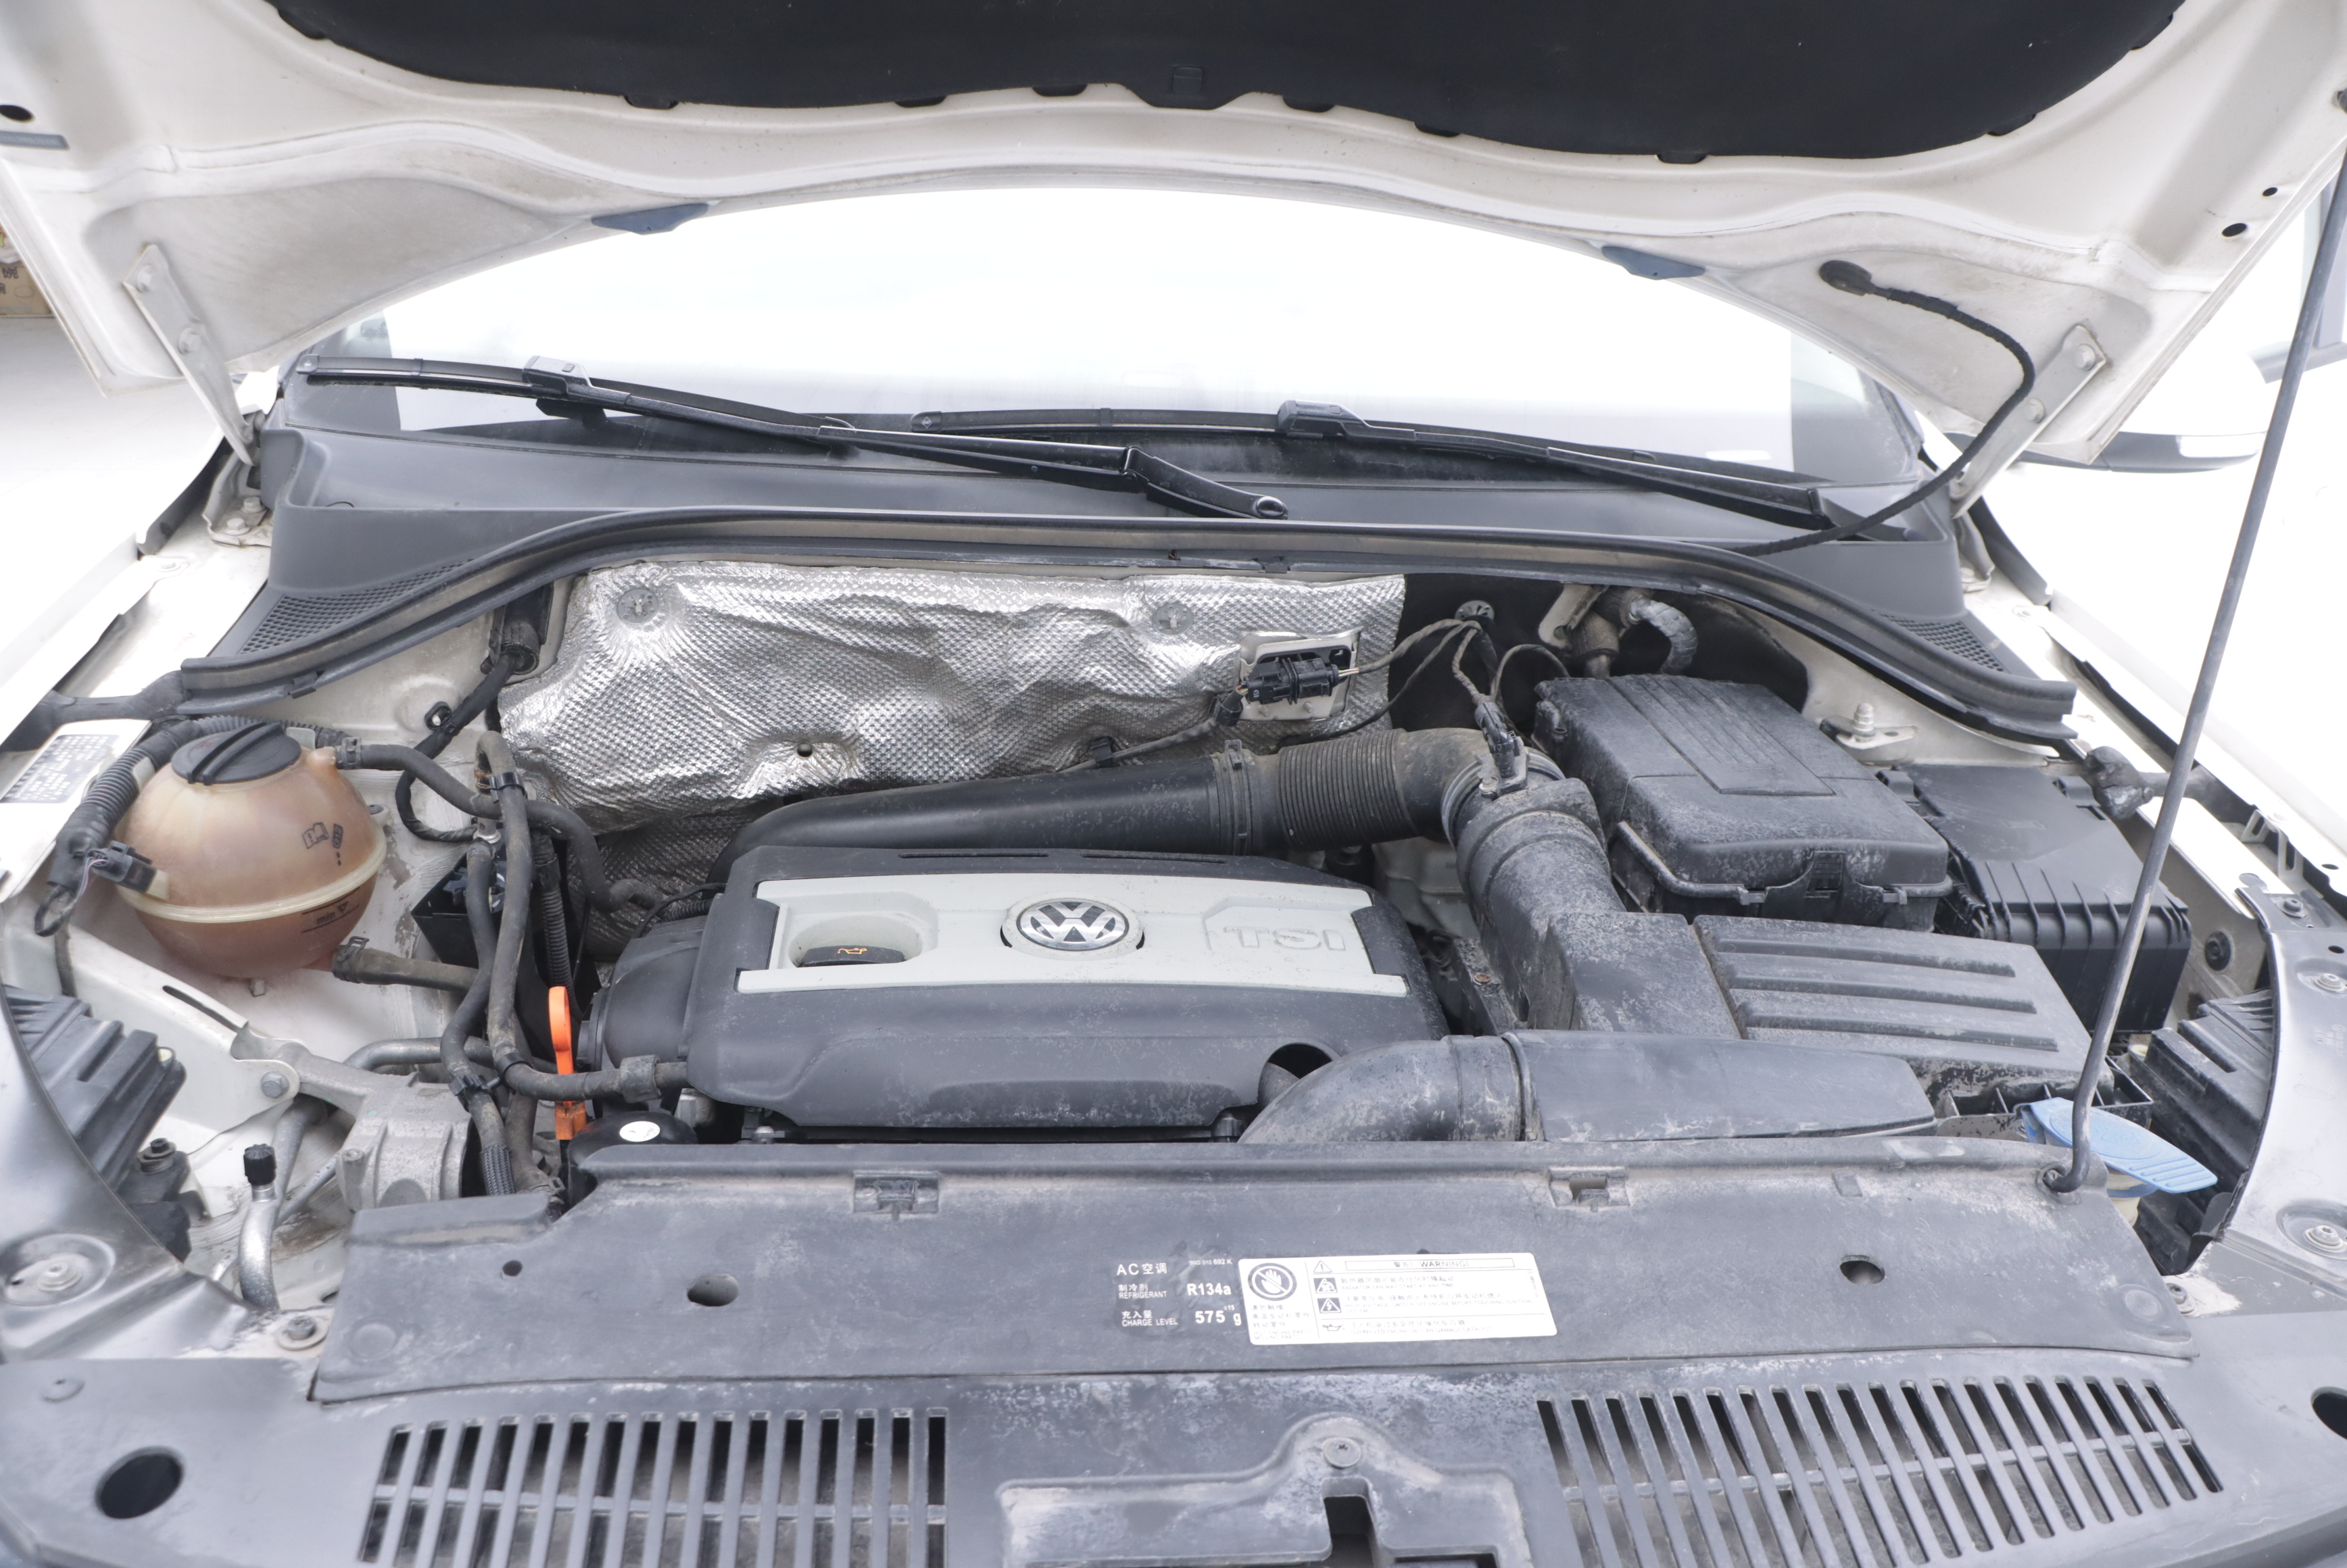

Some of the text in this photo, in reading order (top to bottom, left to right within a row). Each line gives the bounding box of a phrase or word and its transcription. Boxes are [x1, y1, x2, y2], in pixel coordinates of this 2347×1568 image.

[317, 912, 335, 925] min
[1223, 926, 1346, 952] TSI
[1118, 1283, 1148, 1292] 制冷剂
[1187, 1283, 1232, 1296] R134a
[1119, 1291, 1167, 1299] REFRIGERANT
[1121, 1310, 1153, 1319] 充入量
[1195, 1310, 1242, 1325] 575 g
[1122, 1319, 1153, 1327] CHARGE
